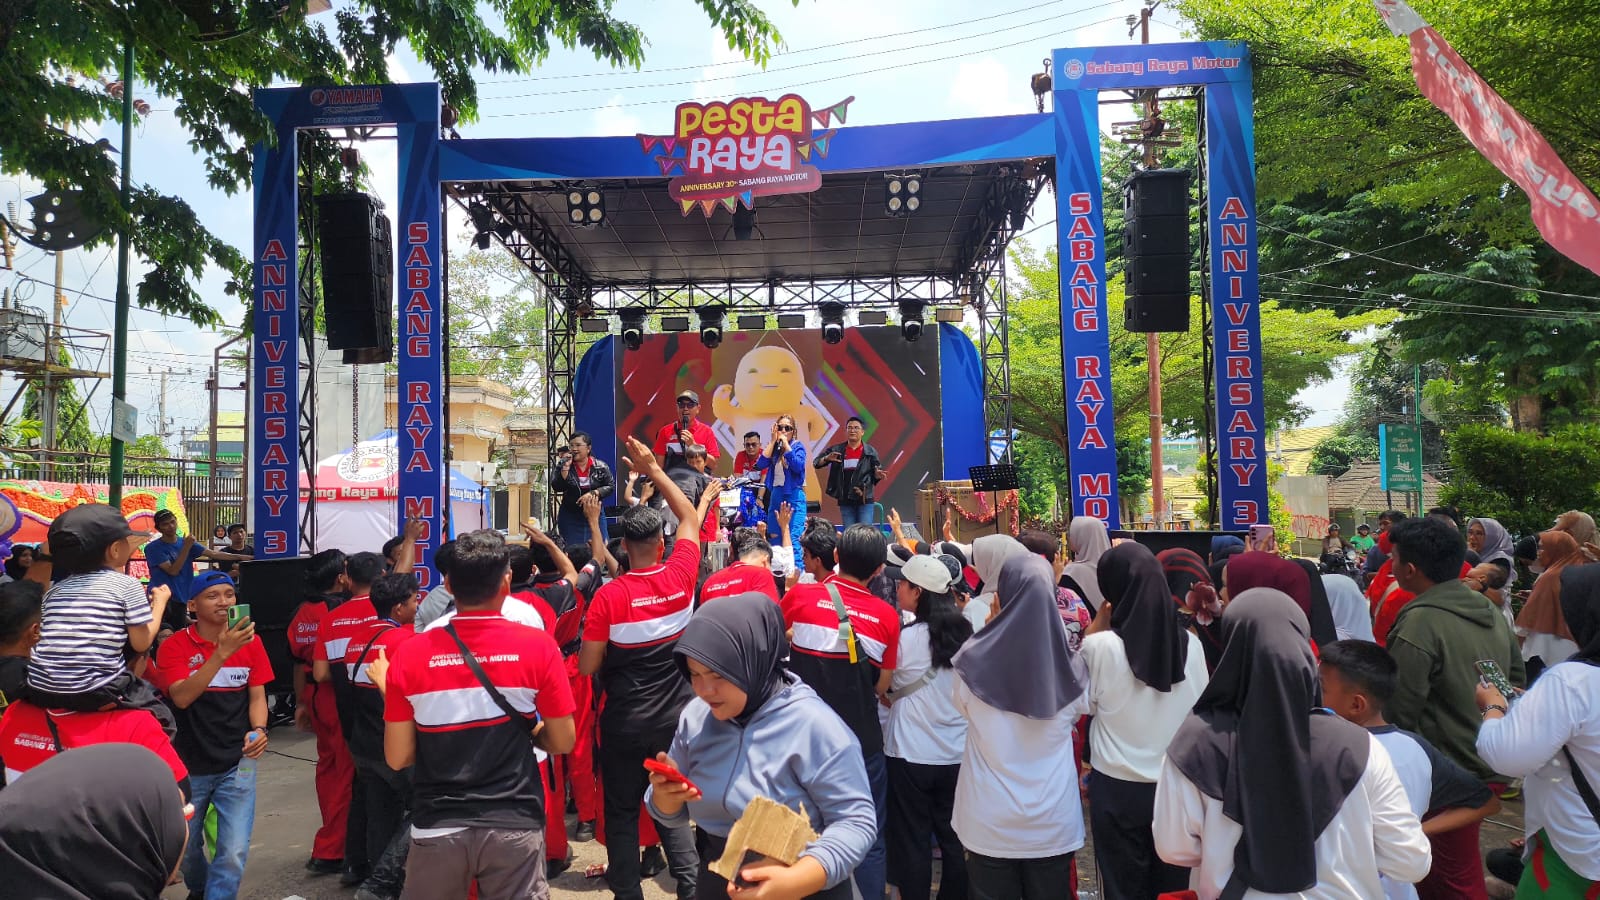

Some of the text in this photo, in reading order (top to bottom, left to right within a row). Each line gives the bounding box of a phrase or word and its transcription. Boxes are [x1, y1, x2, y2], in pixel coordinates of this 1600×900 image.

[1086, 56, 1240, 75] Sabang Raya Motor
[327, 87, 383, 104] YAMAHA
[679, 181, 725, 193] ANNIVERSARY
[739, 177, 766, 186] SABANG
[767, 174, 783, 183] RAYA
[784, 172, 808, 182] MOTOR
[405, 222, 432, 357] SABANG
[1068, 192, 1099, 332] SABANG
[1218, 197, 1258, 487] ANNIVERSARY
[261, 239, 289, 517] ANNIVERSARY
[1075, 355, 1108, 450] RAYA
[405, 382, 433, 472] RAYA
[341, 486, 379, 499] Raya
[429, 658, 465, 668] SABANG
[490, 654, 519, 663] MOTOR
[14, 738, 46, 750] SABANG
